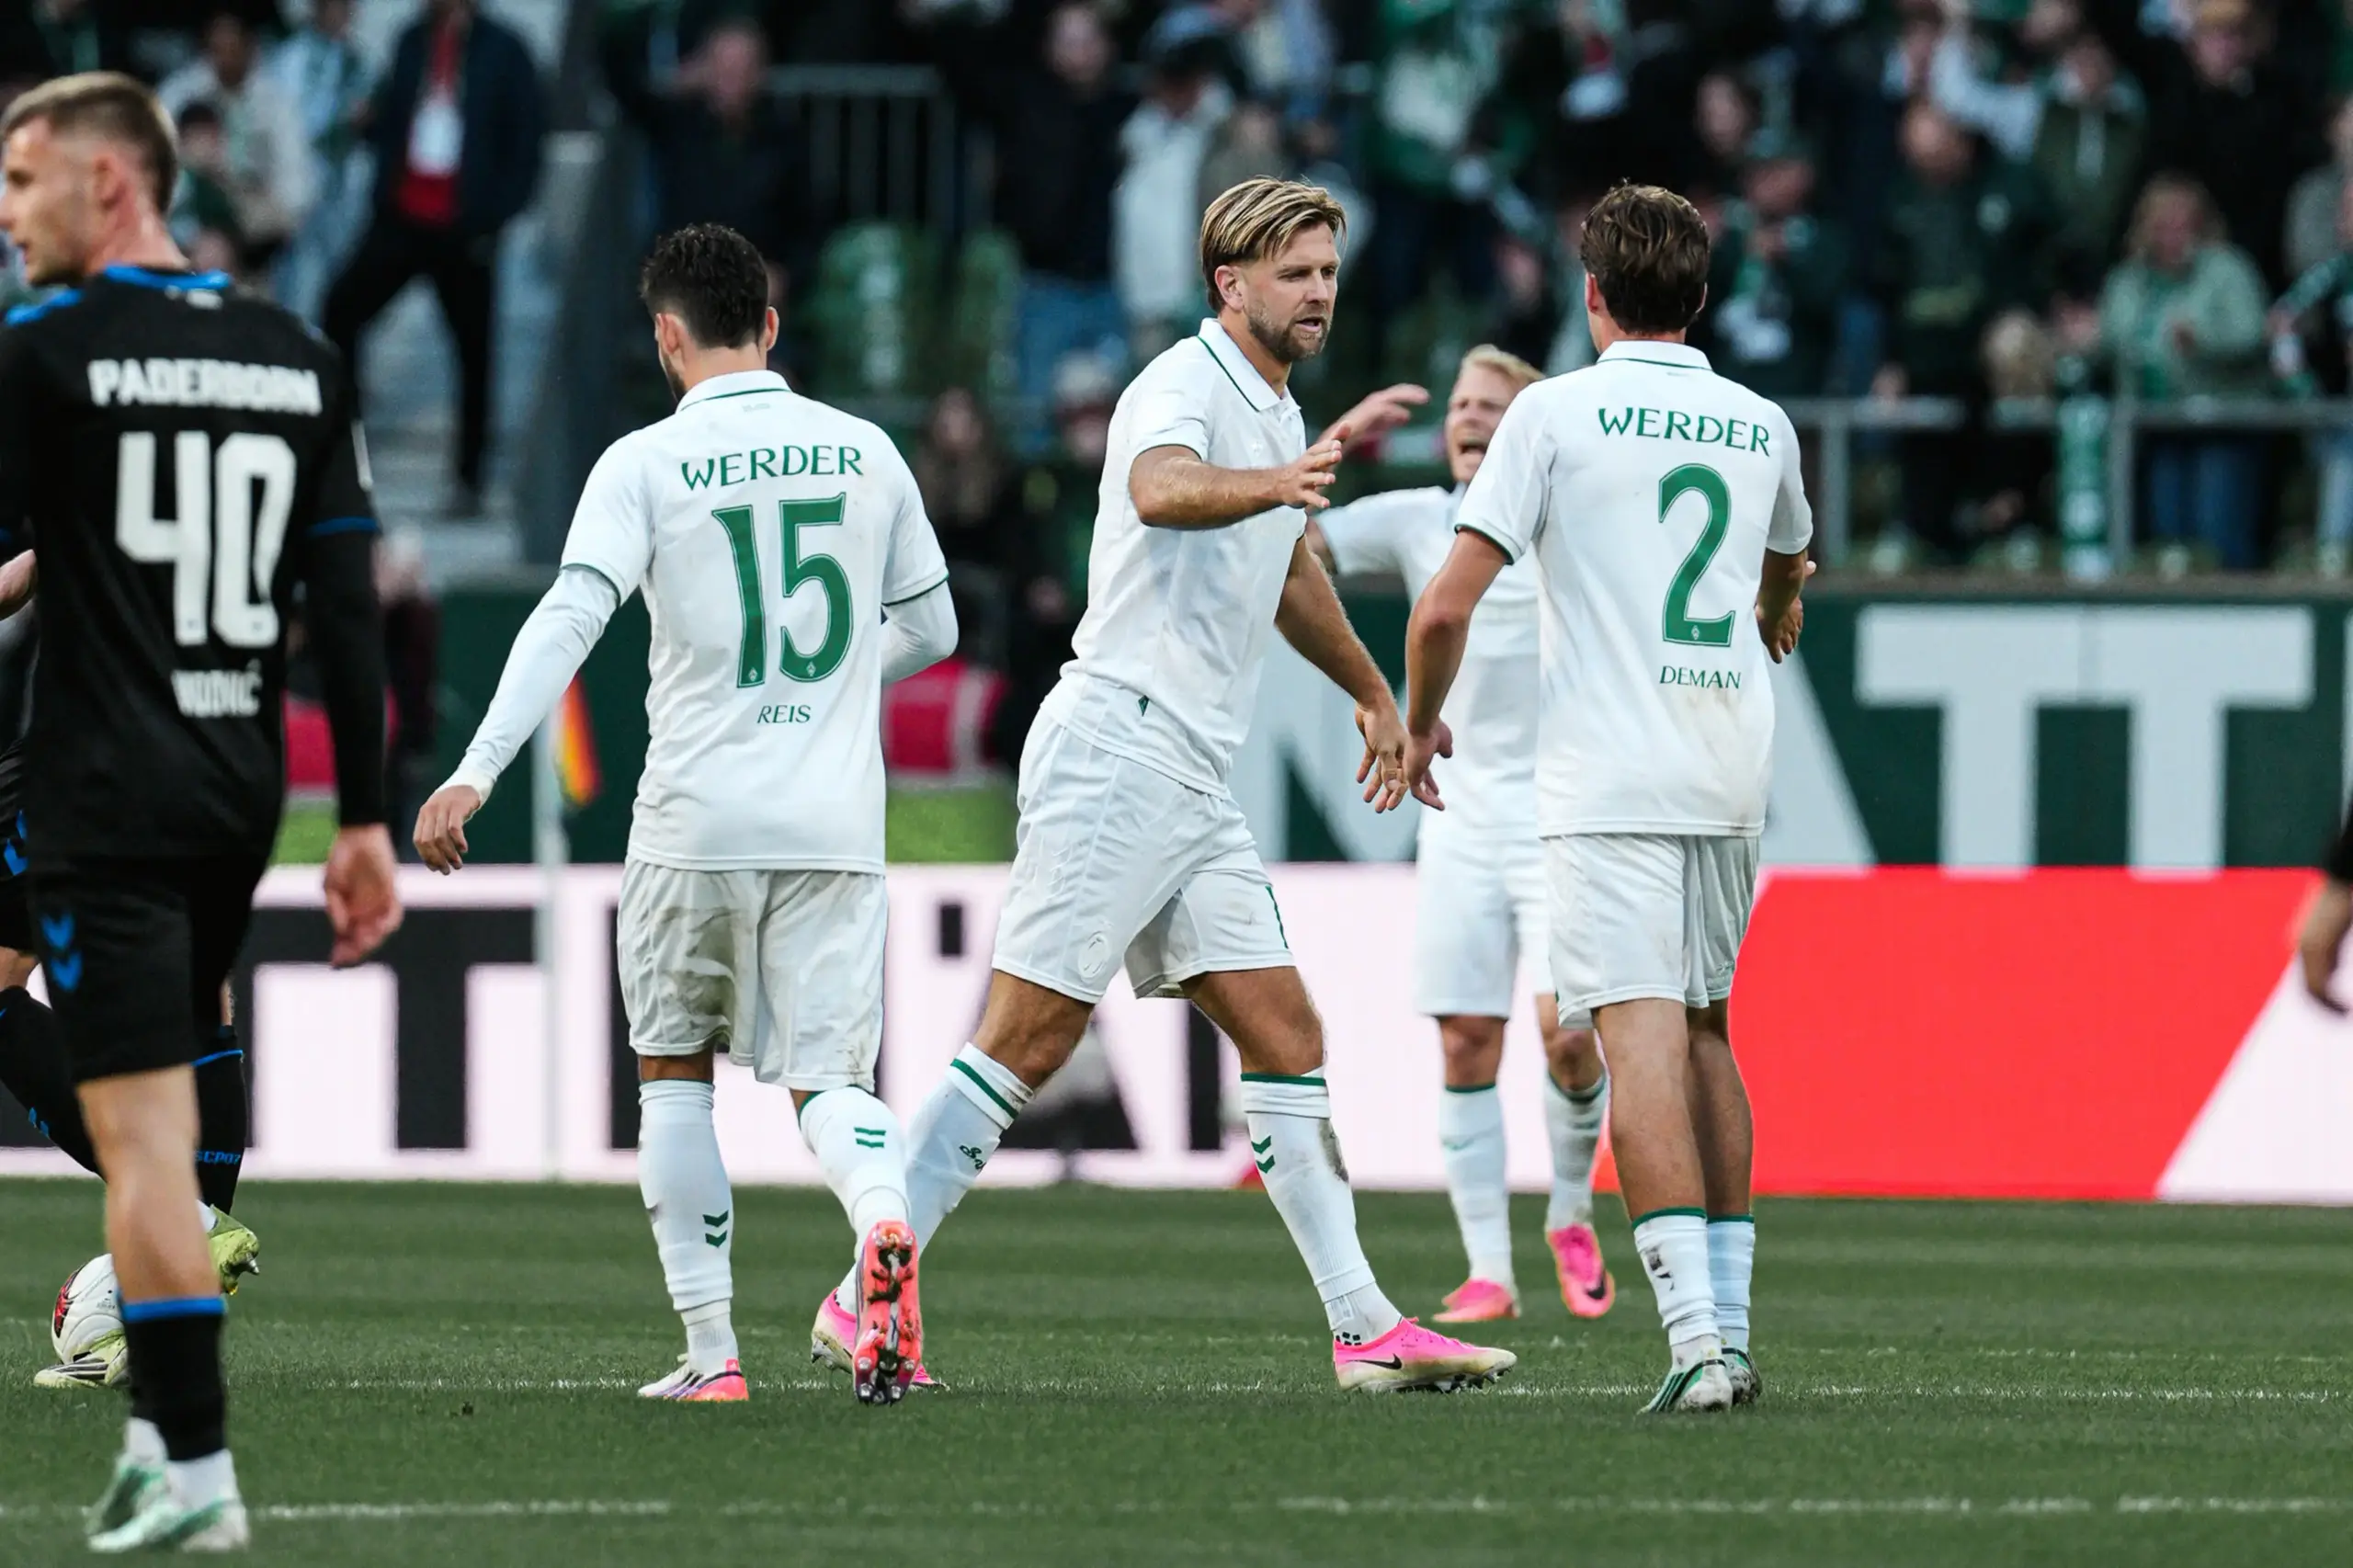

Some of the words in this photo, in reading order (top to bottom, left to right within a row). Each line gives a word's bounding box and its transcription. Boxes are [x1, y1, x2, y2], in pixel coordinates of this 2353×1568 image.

[87, 357, 322, 417] PADERBORN
[1598, 406, 1770, 458] WERDER
[681, 444, 864, 491] WERDER
[115, 430, 297, 647] 40
[1658, 462, 1736, 647] 2
[710, 492, 854, 688] 15
[1659, 665, 1742, 689] DEMAN
[756, 704, 812, 724] REIS
